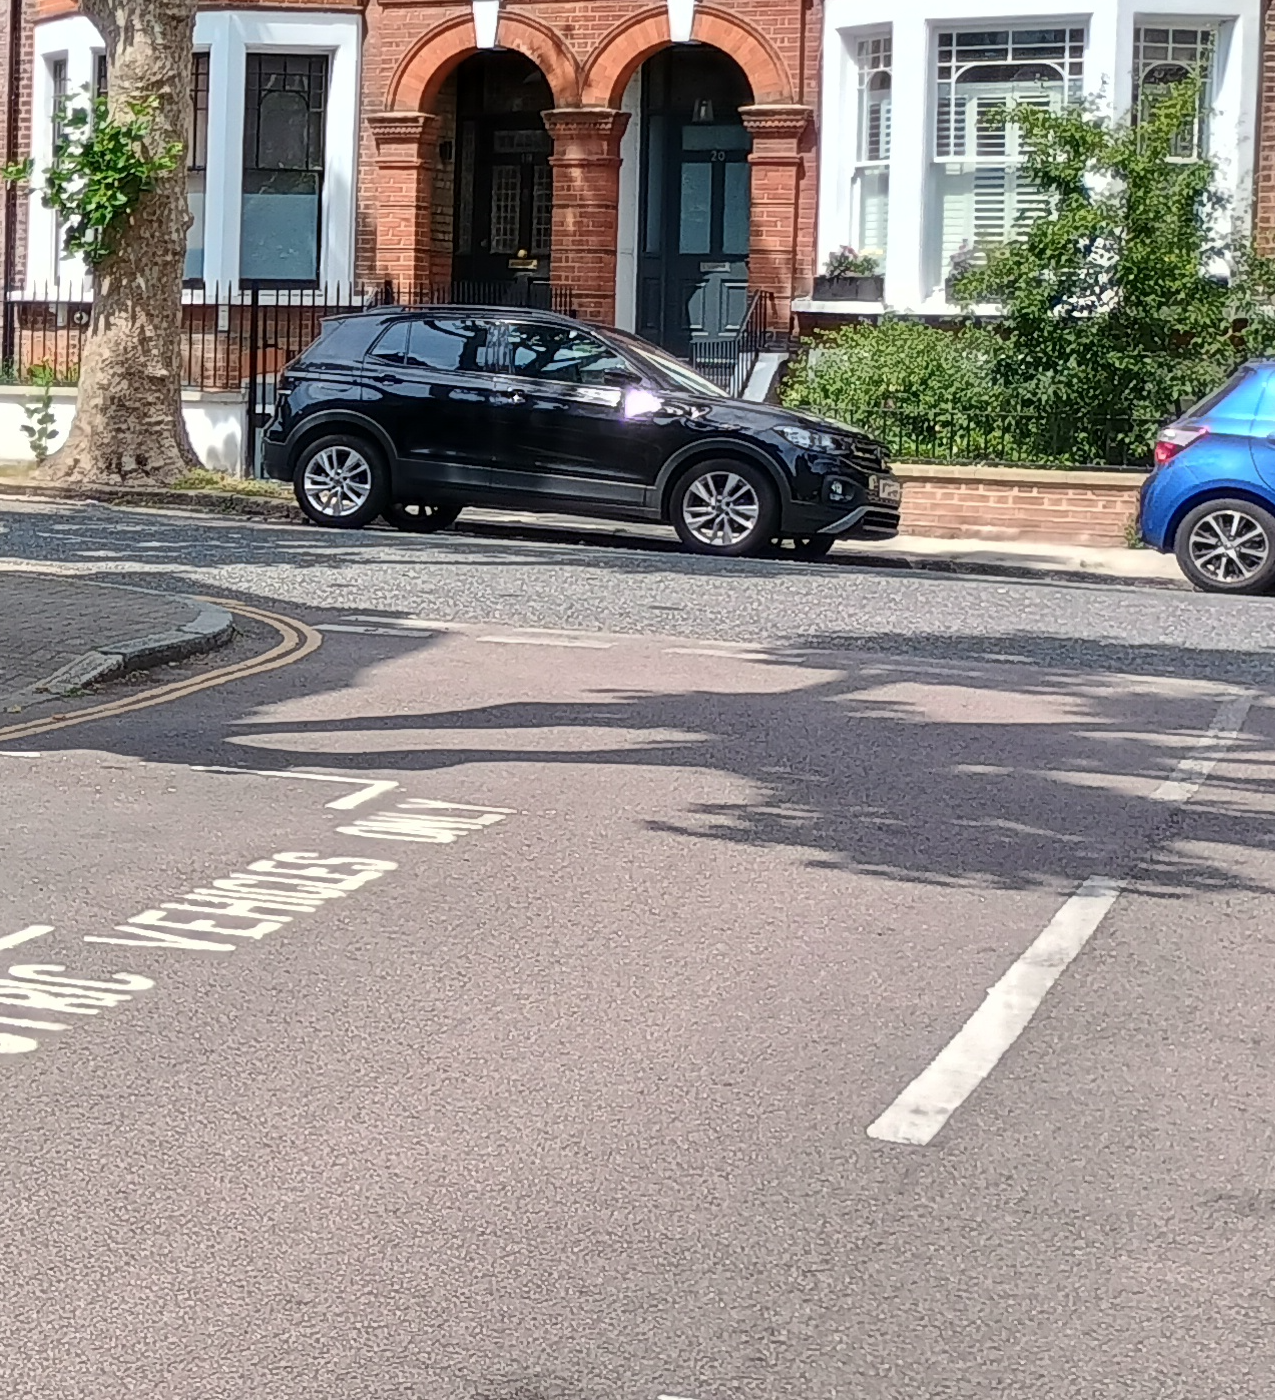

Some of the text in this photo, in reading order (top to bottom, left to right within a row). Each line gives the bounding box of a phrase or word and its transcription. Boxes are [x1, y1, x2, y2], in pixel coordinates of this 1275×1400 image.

[710, 150, 726, 162] 20
[83, 850, 399, 952] VEHICLES
[335, 797, 518, 844] ONLY
